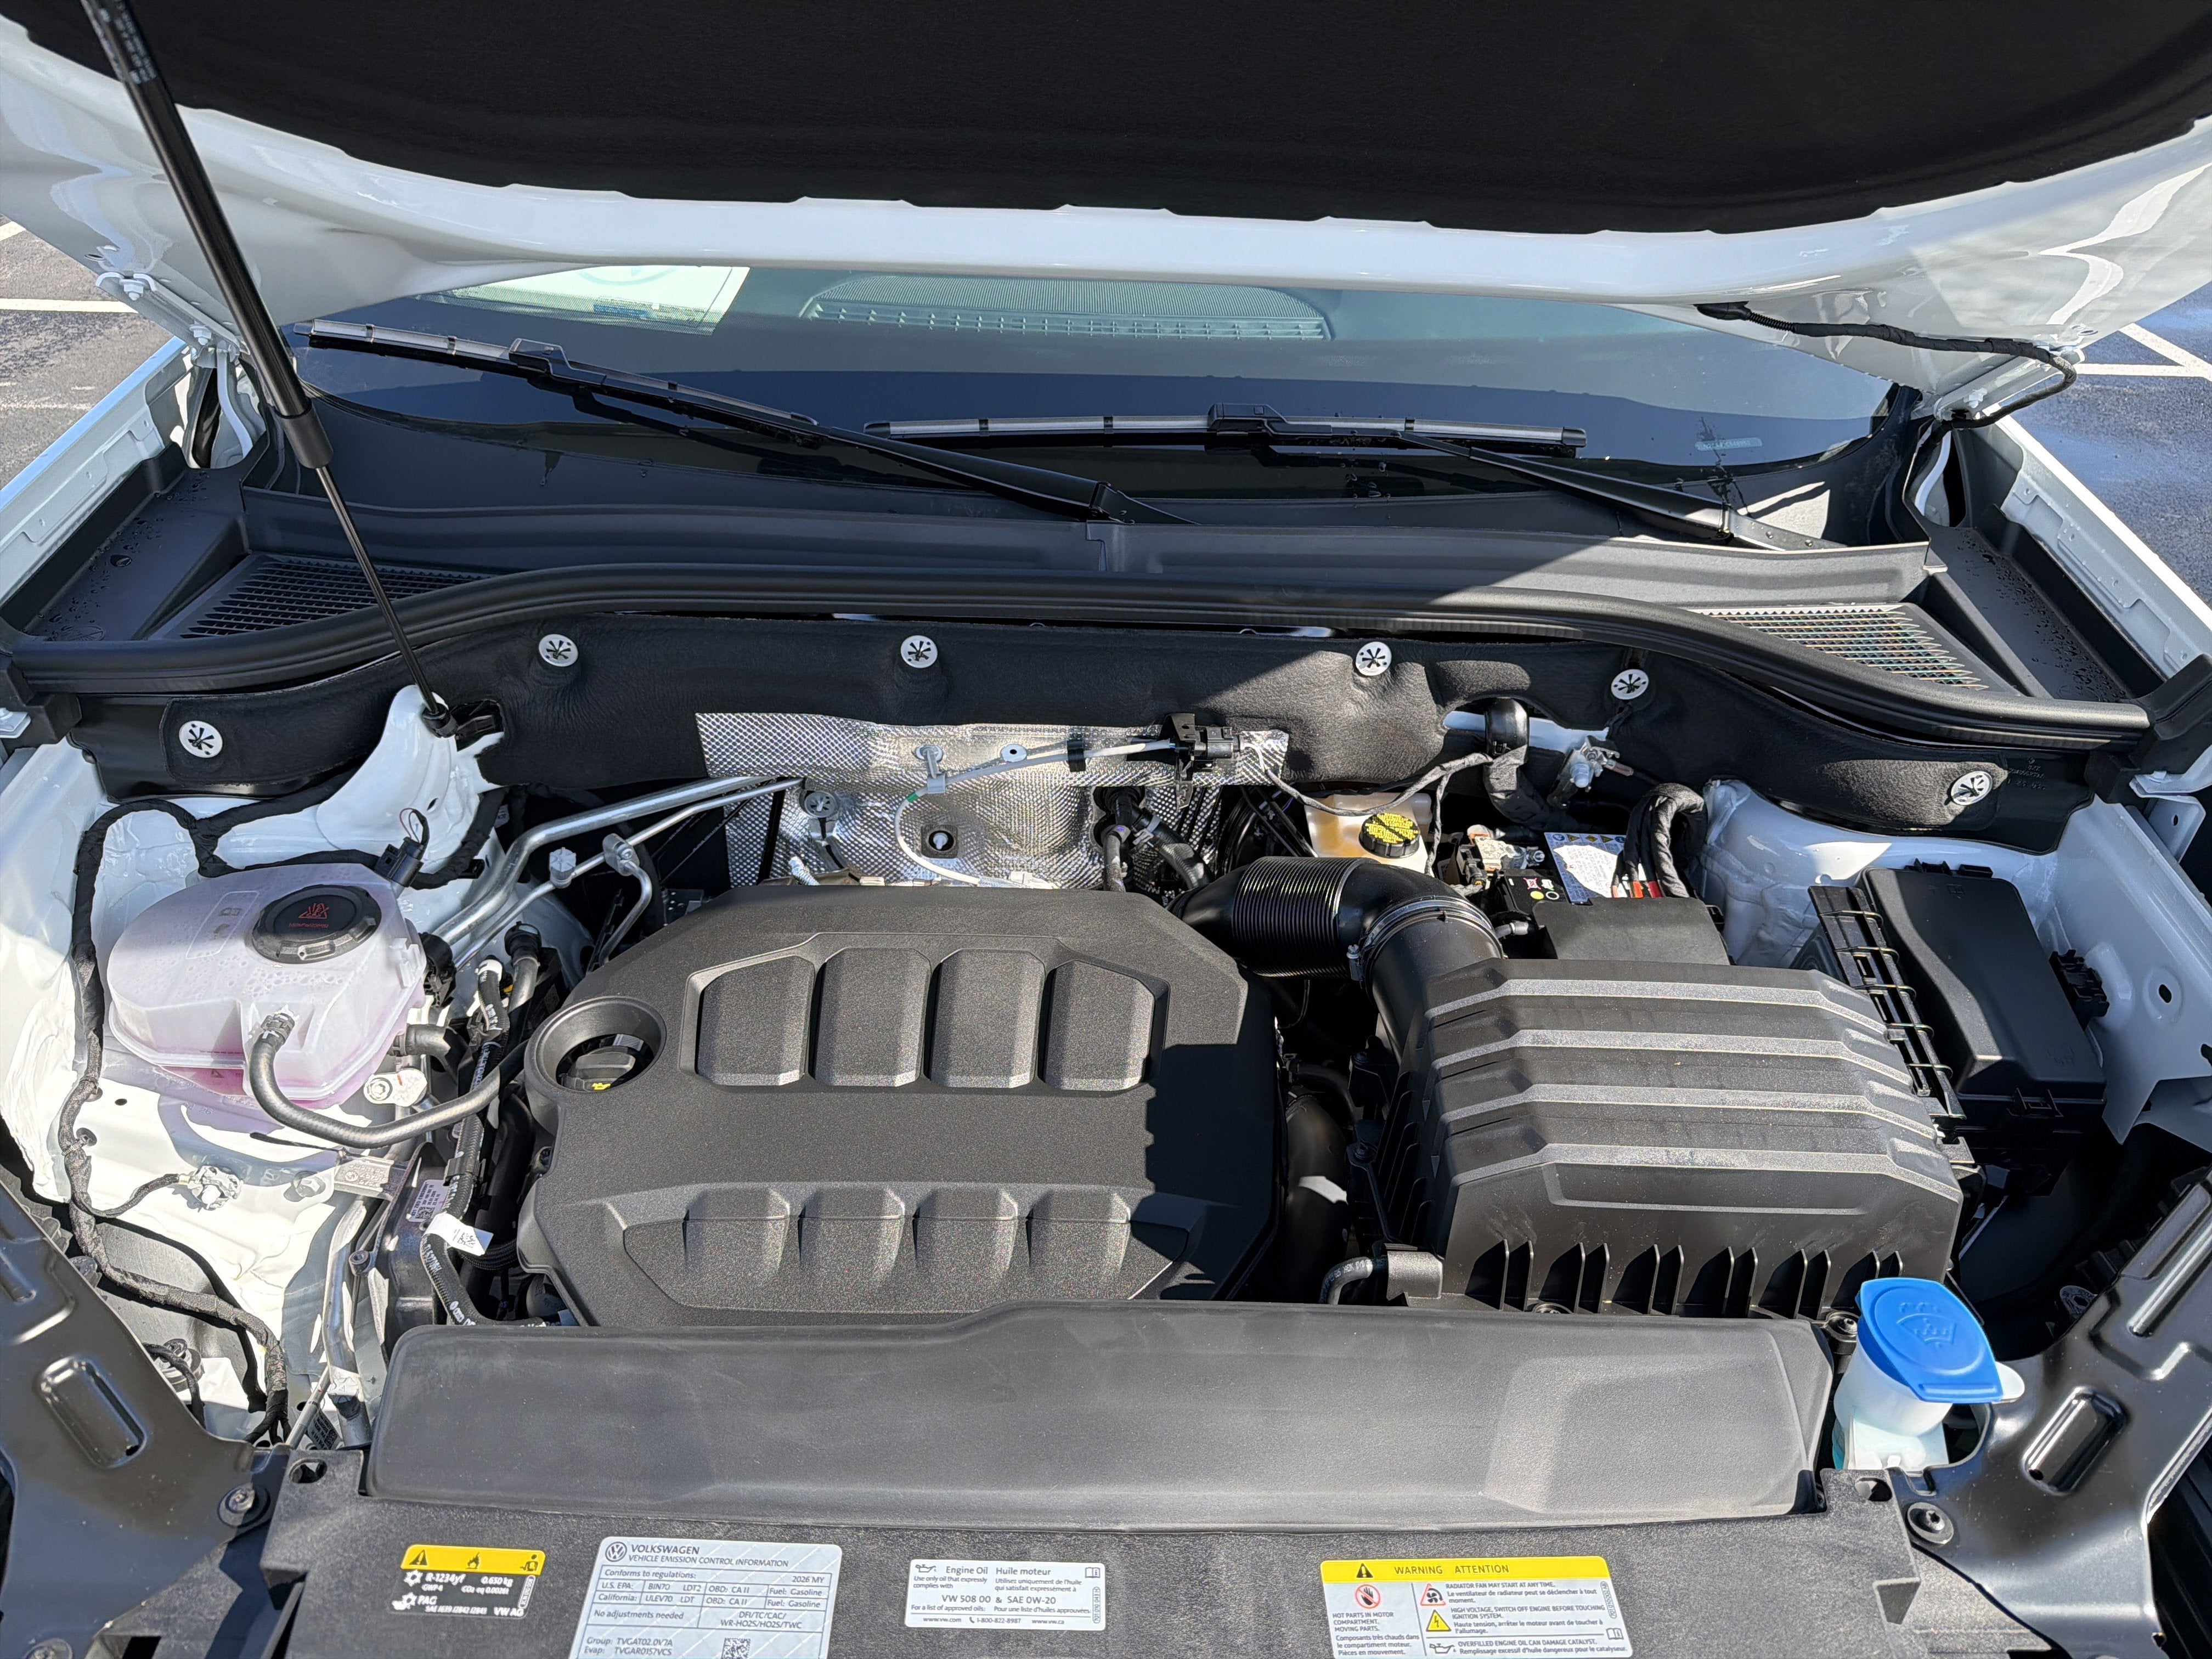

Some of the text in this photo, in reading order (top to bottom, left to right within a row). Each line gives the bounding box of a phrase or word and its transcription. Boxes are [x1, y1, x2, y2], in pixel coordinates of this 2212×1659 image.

[631, 1544, 699, 1554] VOLKSWAGEN
[736, 1559, 789, 1567] INFORMATION
[946, 1566, 974, 1576] Engine
[1394, 1565, 1509, 1575] WARNING ATTENTION
[417, 1595, 437, 1605] PAG
[494, 1607, 510, 1616] VW
[510, 1608, 524, 1617] AG
[607, 1610, 653, 1619] adjustments
[739, 1611, 787, 1619] DFI/TC/CAC/
[720, 1620, 802, 1629] WR-HO2S/HO2S/TWC
[587, 1637, 612, 1645] Group:
